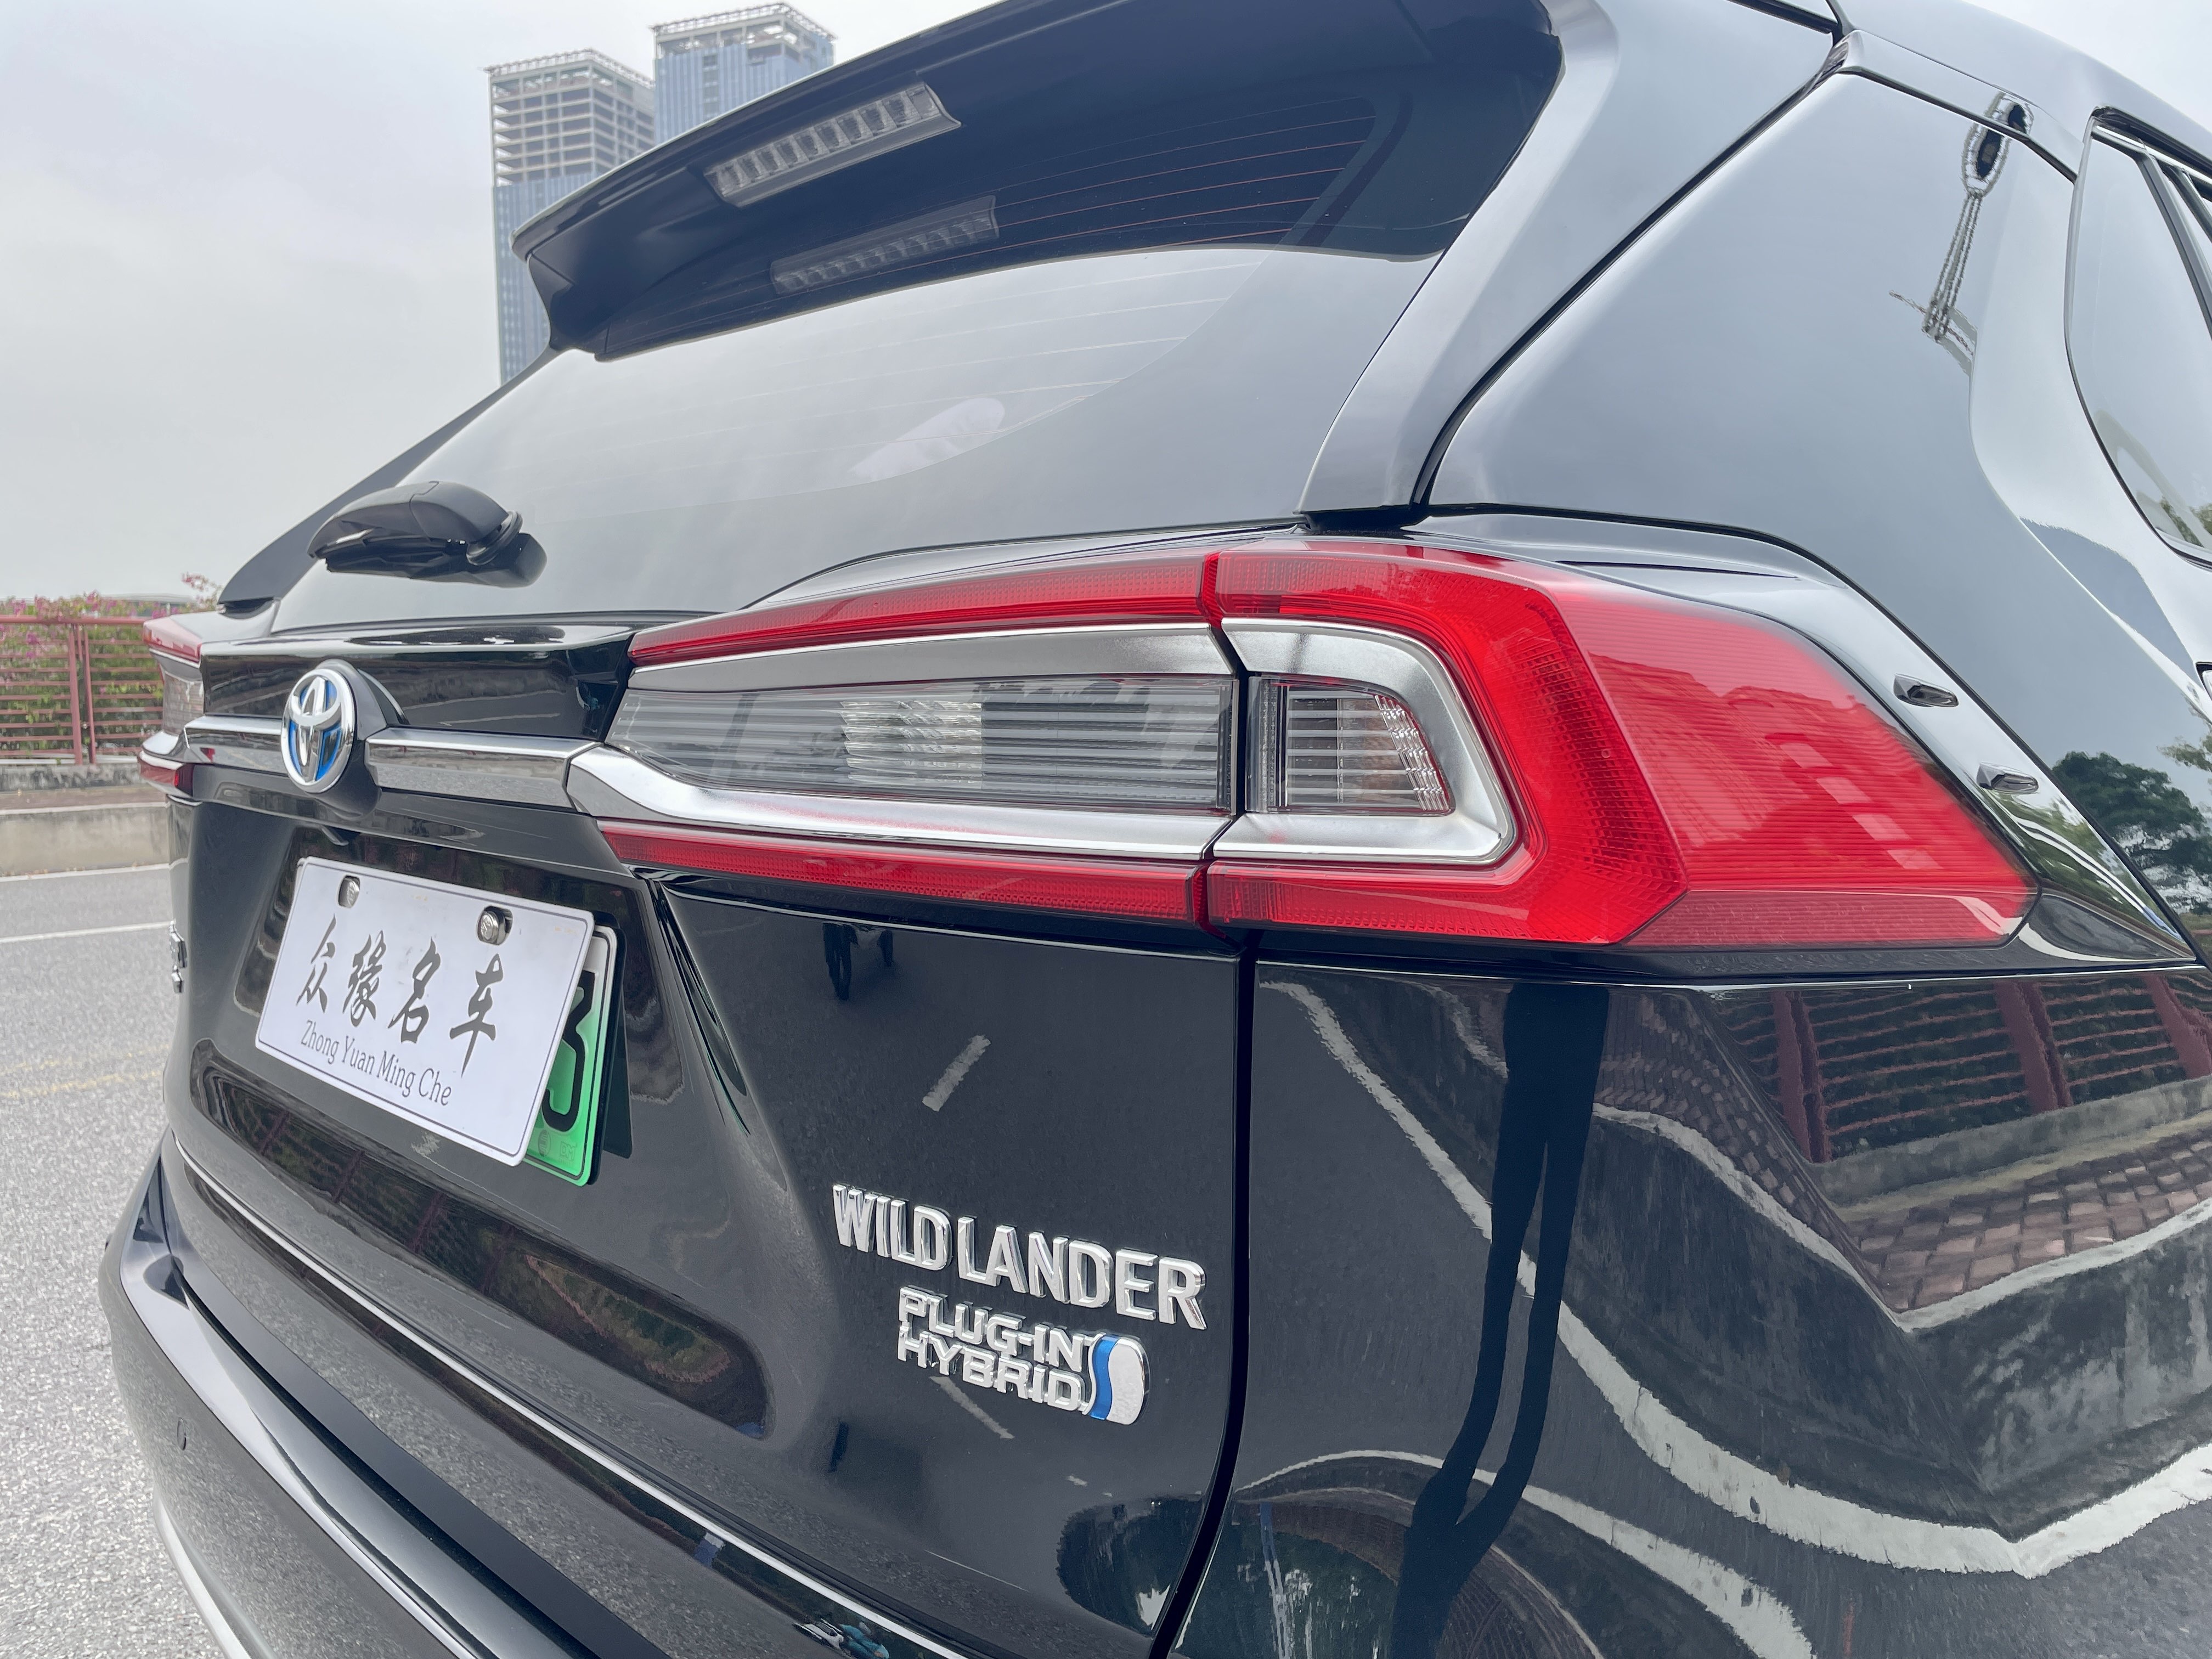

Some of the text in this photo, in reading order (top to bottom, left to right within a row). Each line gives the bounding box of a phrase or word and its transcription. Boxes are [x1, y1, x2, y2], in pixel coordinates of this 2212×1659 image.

[301, 1020, 452, 1107] Zhong Yuan Ming Che
[896, 1325, 1086, 1412] HYBRID
[898, 1285, 1086, 1372] PLUG-IN
